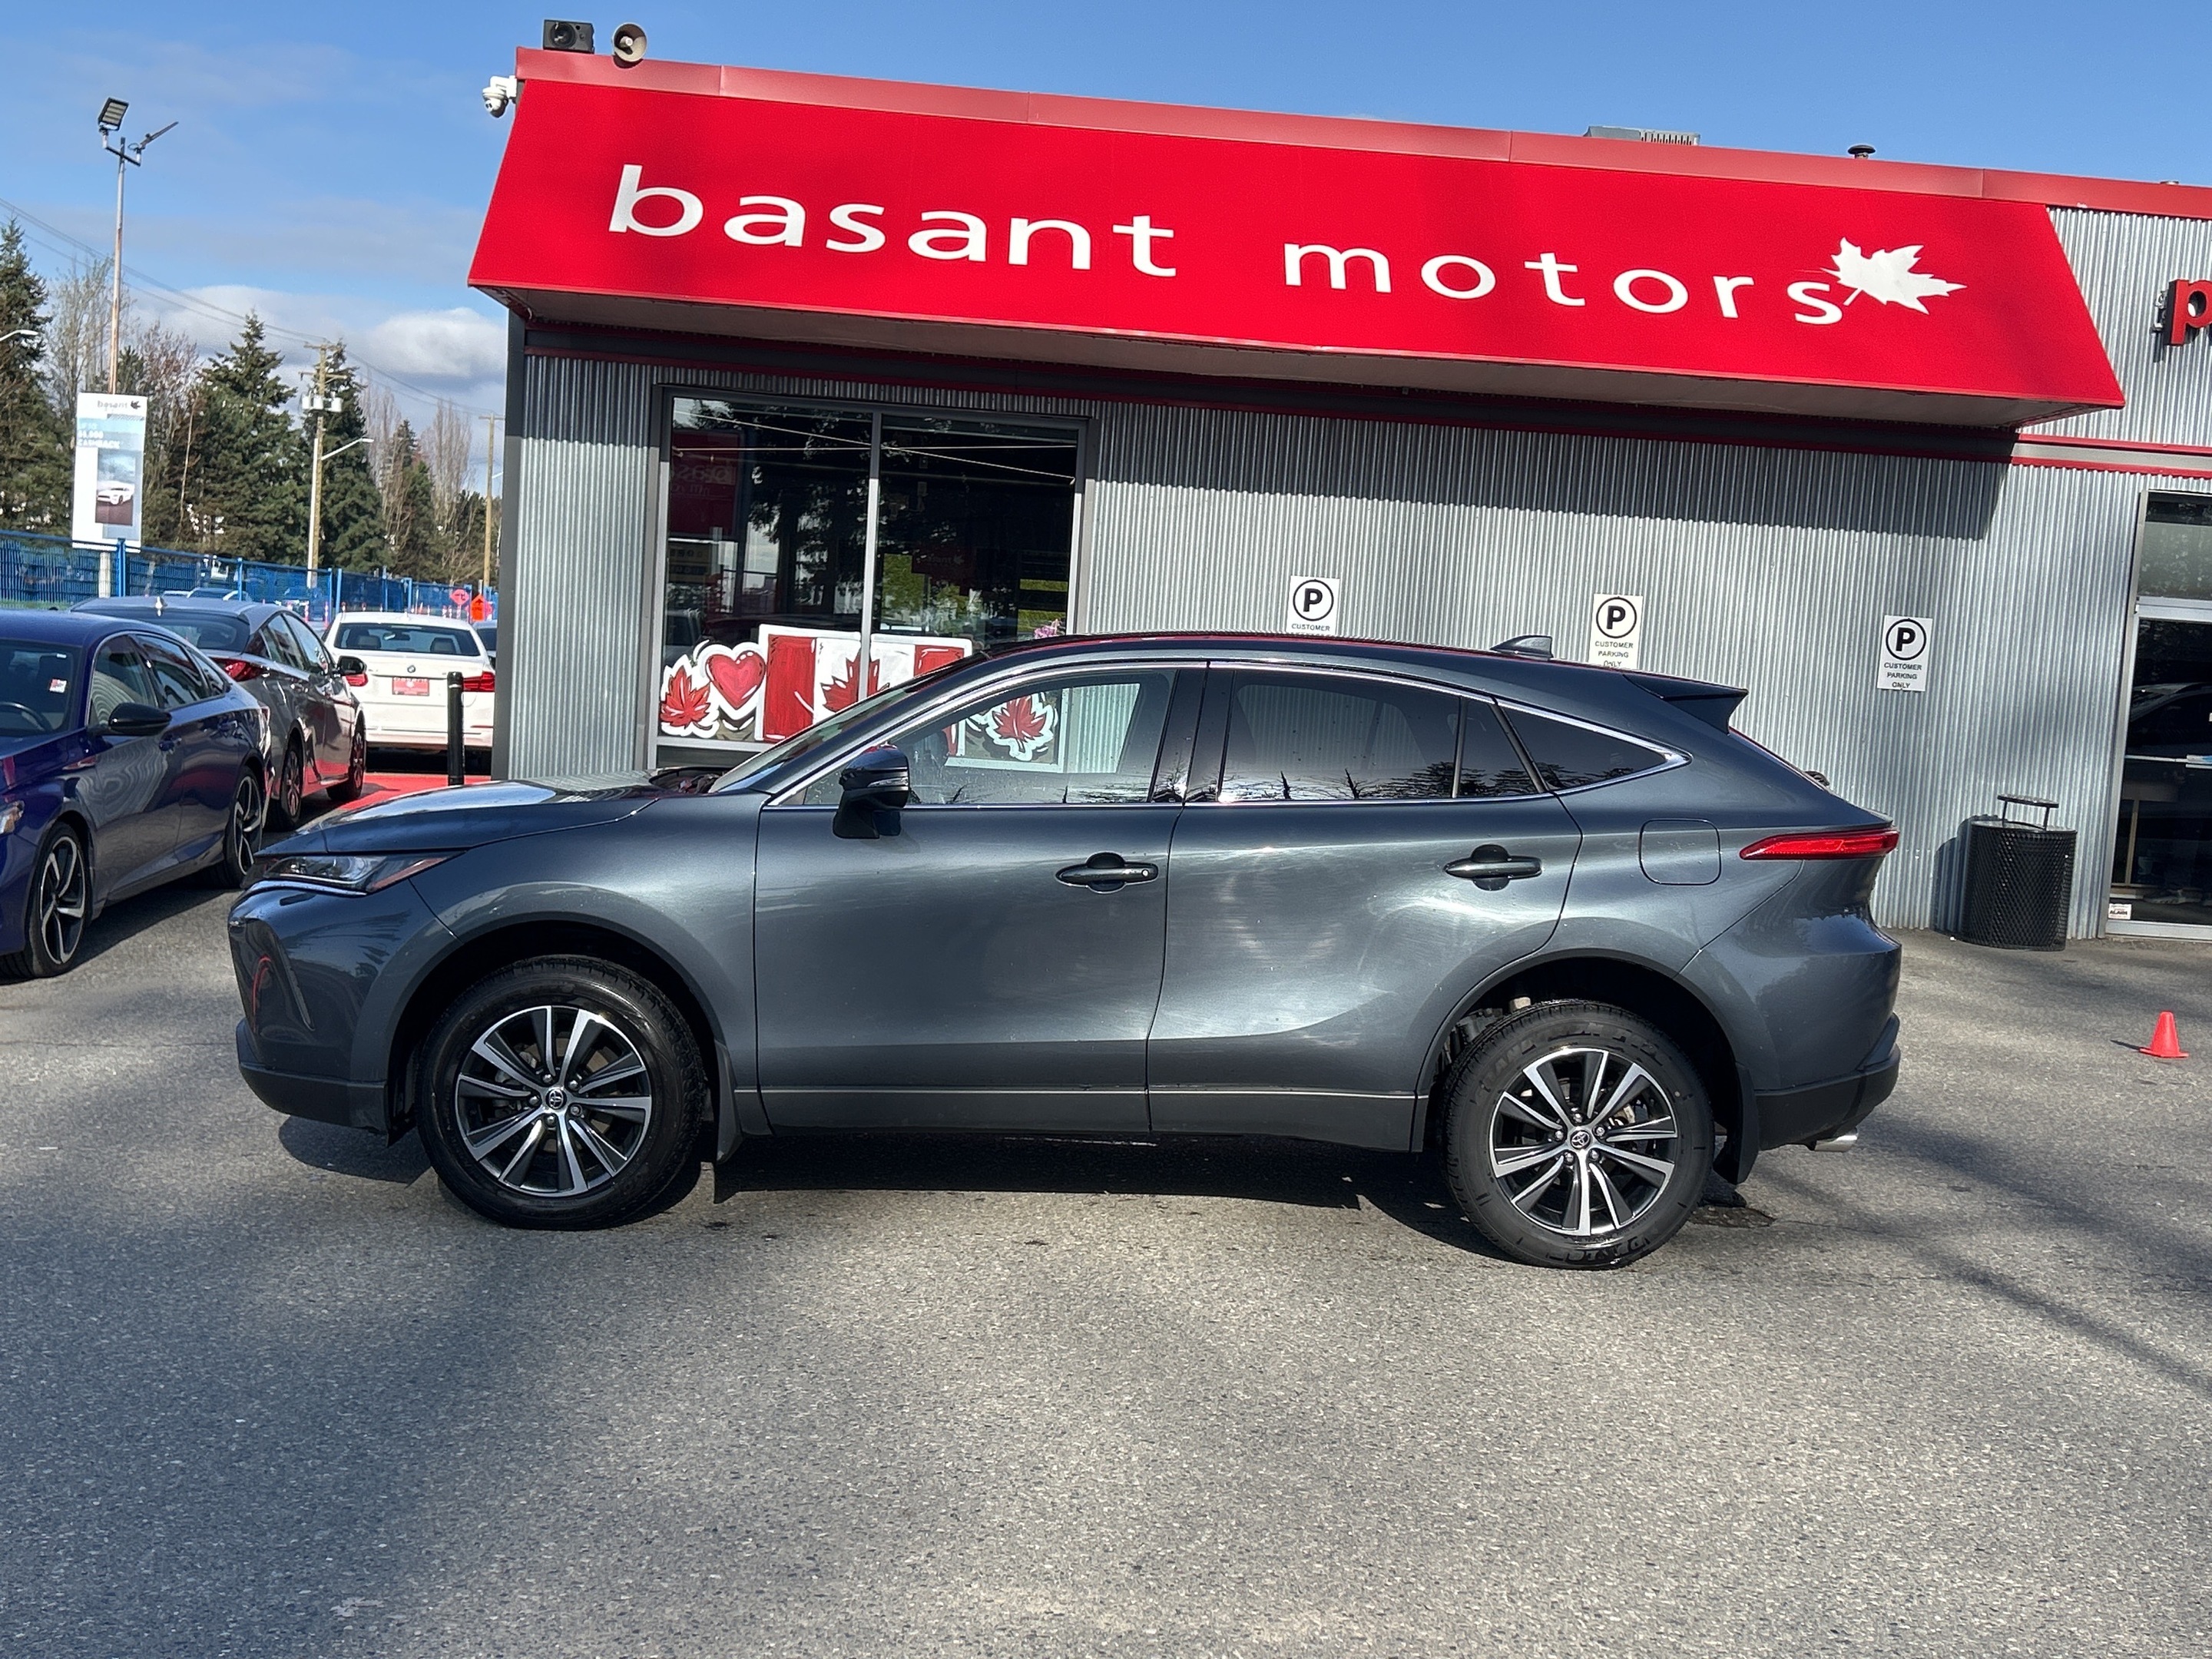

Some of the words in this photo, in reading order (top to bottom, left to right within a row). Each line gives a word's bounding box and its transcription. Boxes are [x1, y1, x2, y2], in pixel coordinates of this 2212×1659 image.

[608, 164, 1177, 277] basant
[1284, 243, 1843, 325] motors
[1303, 588, 1323, 612] P
[1291, 623, 1331, 631] CUSTOMER
[1606, 604, 1626, 630] P
[1594, 641, 1634, 649] CUSTOMER
[1896, 627, 1916, 652] P
[1883, 662, 1922, 671] CUSTOMER
